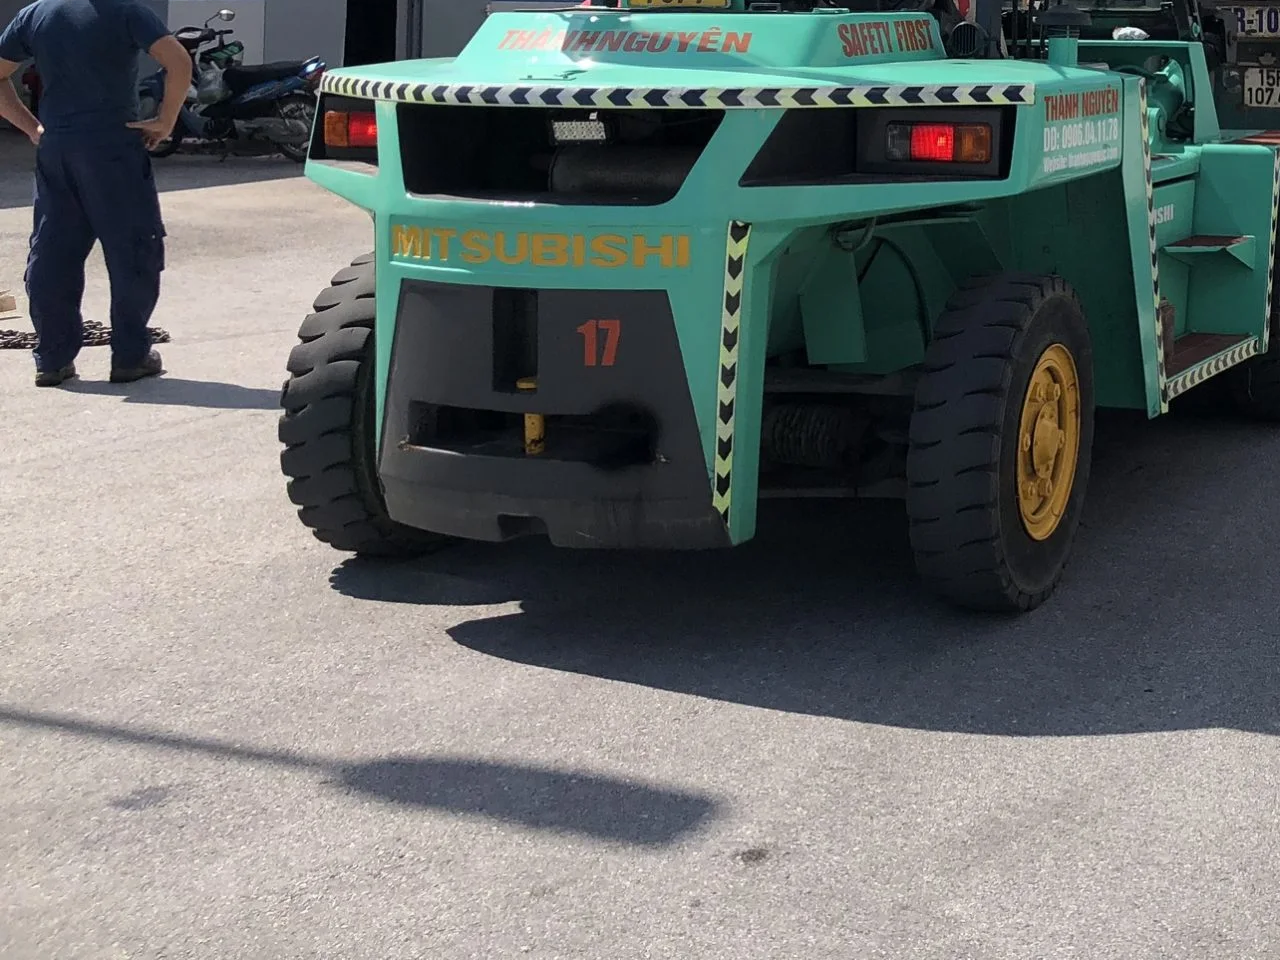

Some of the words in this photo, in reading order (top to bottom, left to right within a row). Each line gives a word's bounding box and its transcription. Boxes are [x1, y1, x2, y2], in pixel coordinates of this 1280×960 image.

[837, 21, 893, 58] SAFETY
[893, 19, 934, 52] FIRST
[1044, 89, 1079, 122] THÀNH
[391, 224, 691, 268] MITSUBISHI
[577, 319, 621, 366] 17
